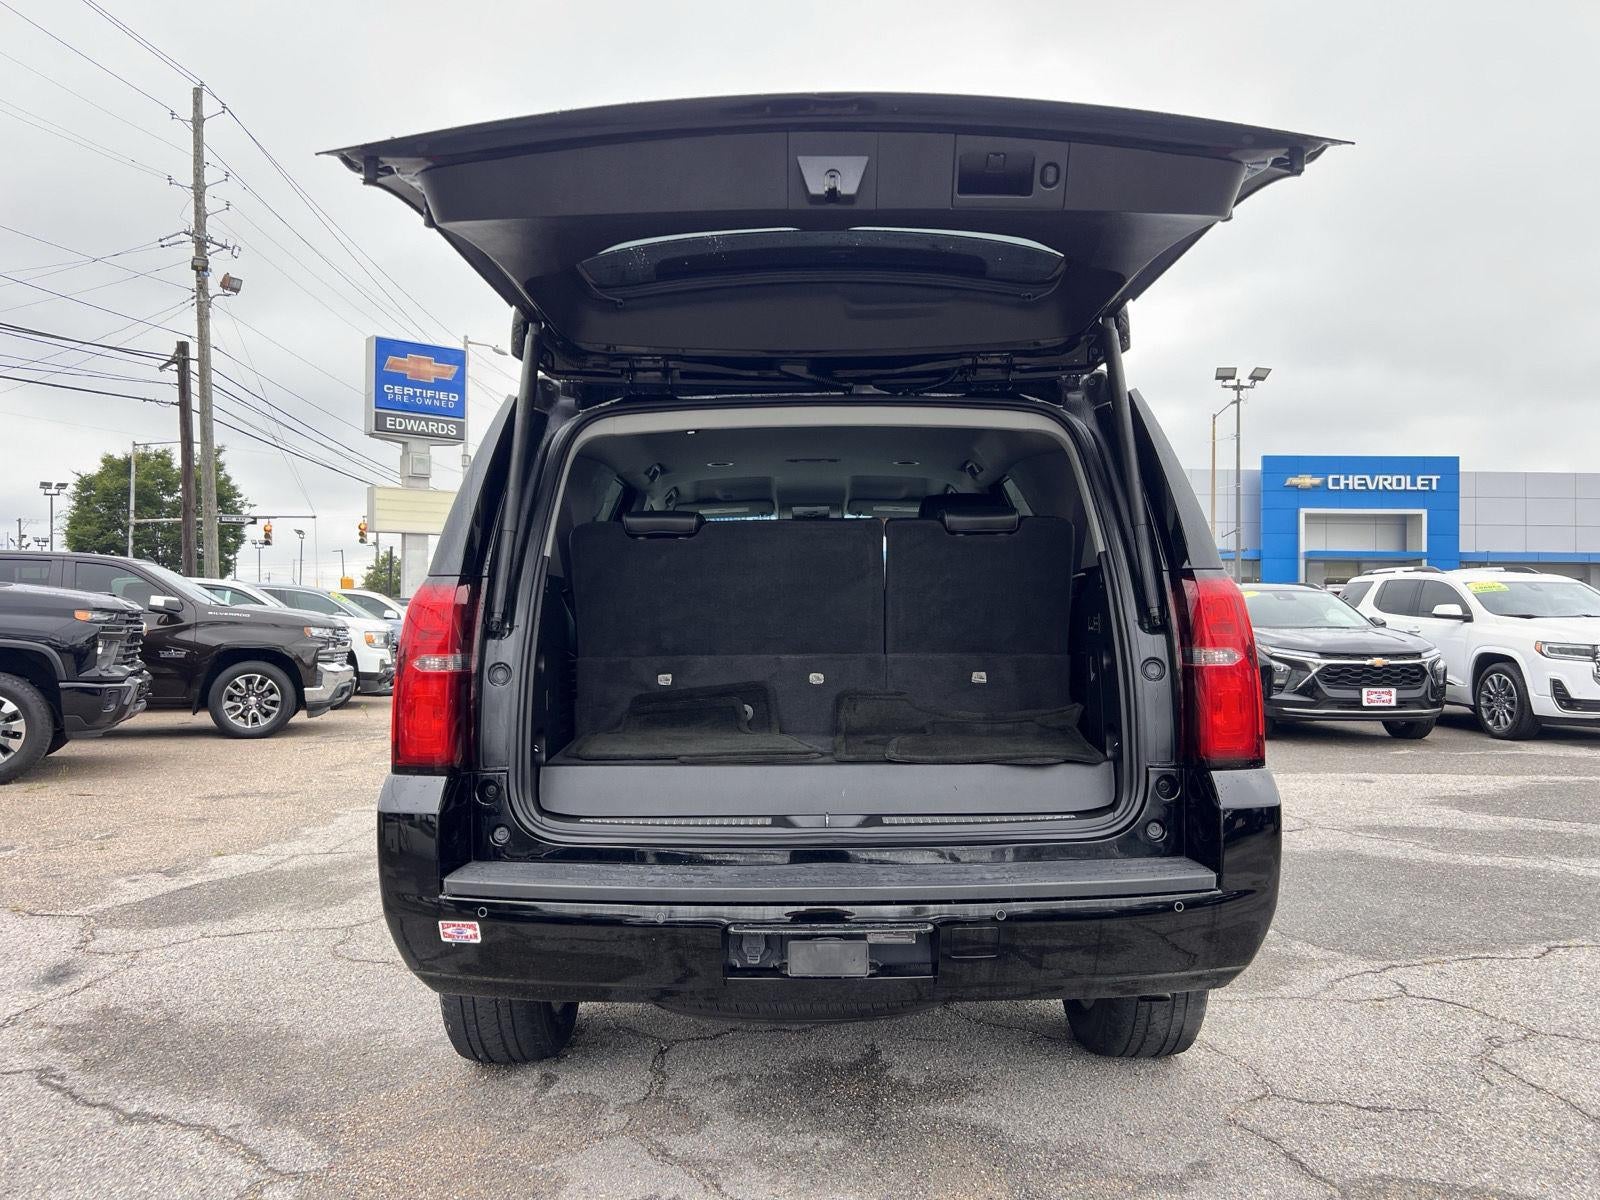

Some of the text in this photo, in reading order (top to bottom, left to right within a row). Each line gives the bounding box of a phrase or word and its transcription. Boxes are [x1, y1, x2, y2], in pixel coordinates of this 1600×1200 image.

[384, 384, 459, 401] CERTIFIED
[387, 394, 455, 408] PRE-OWNED
[386, 416, 457, 435] EDWARDS
[1327, 474, 1441, 490] CHEVROLET
